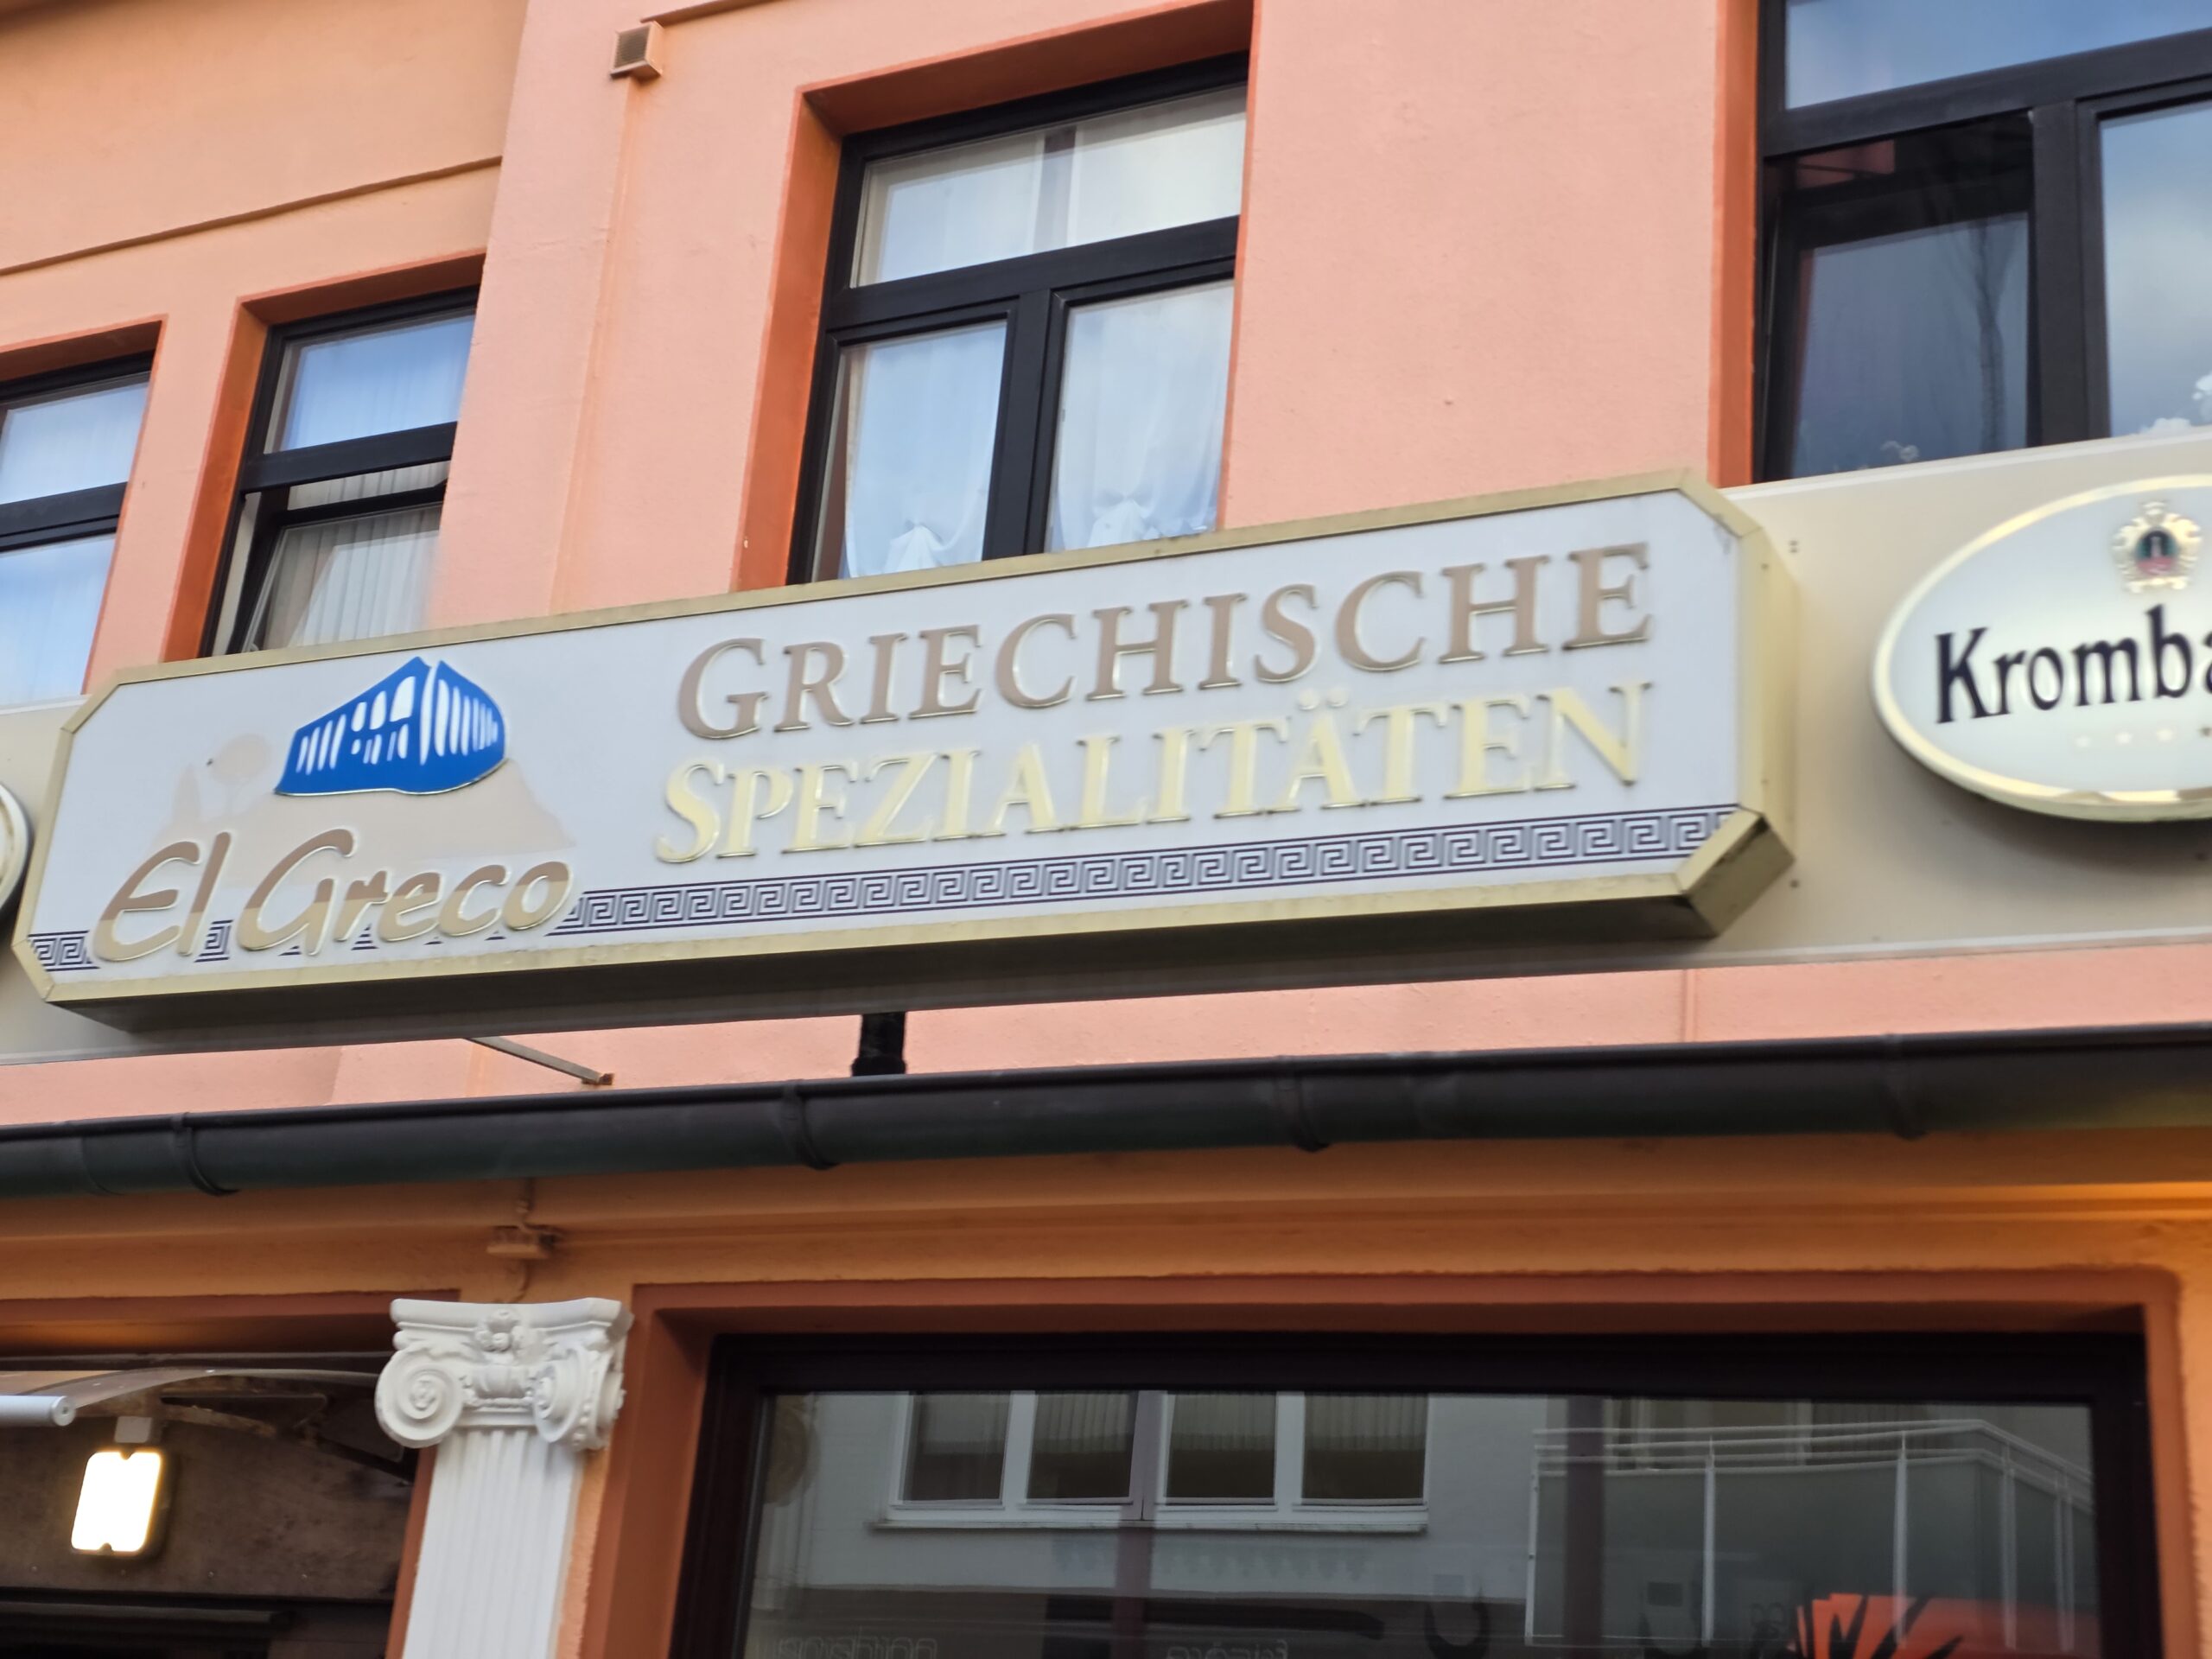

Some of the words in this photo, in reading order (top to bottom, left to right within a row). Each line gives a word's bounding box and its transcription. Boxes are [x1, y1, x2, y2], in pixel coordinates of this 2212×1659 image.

[677, 542, 1652, 740] GRIECHISCHE
[655, 682, 1653, 864] SPEZIALITÄTEN
[92, 831, 232, 963] El
[236, 828, 574, 957] Greco
